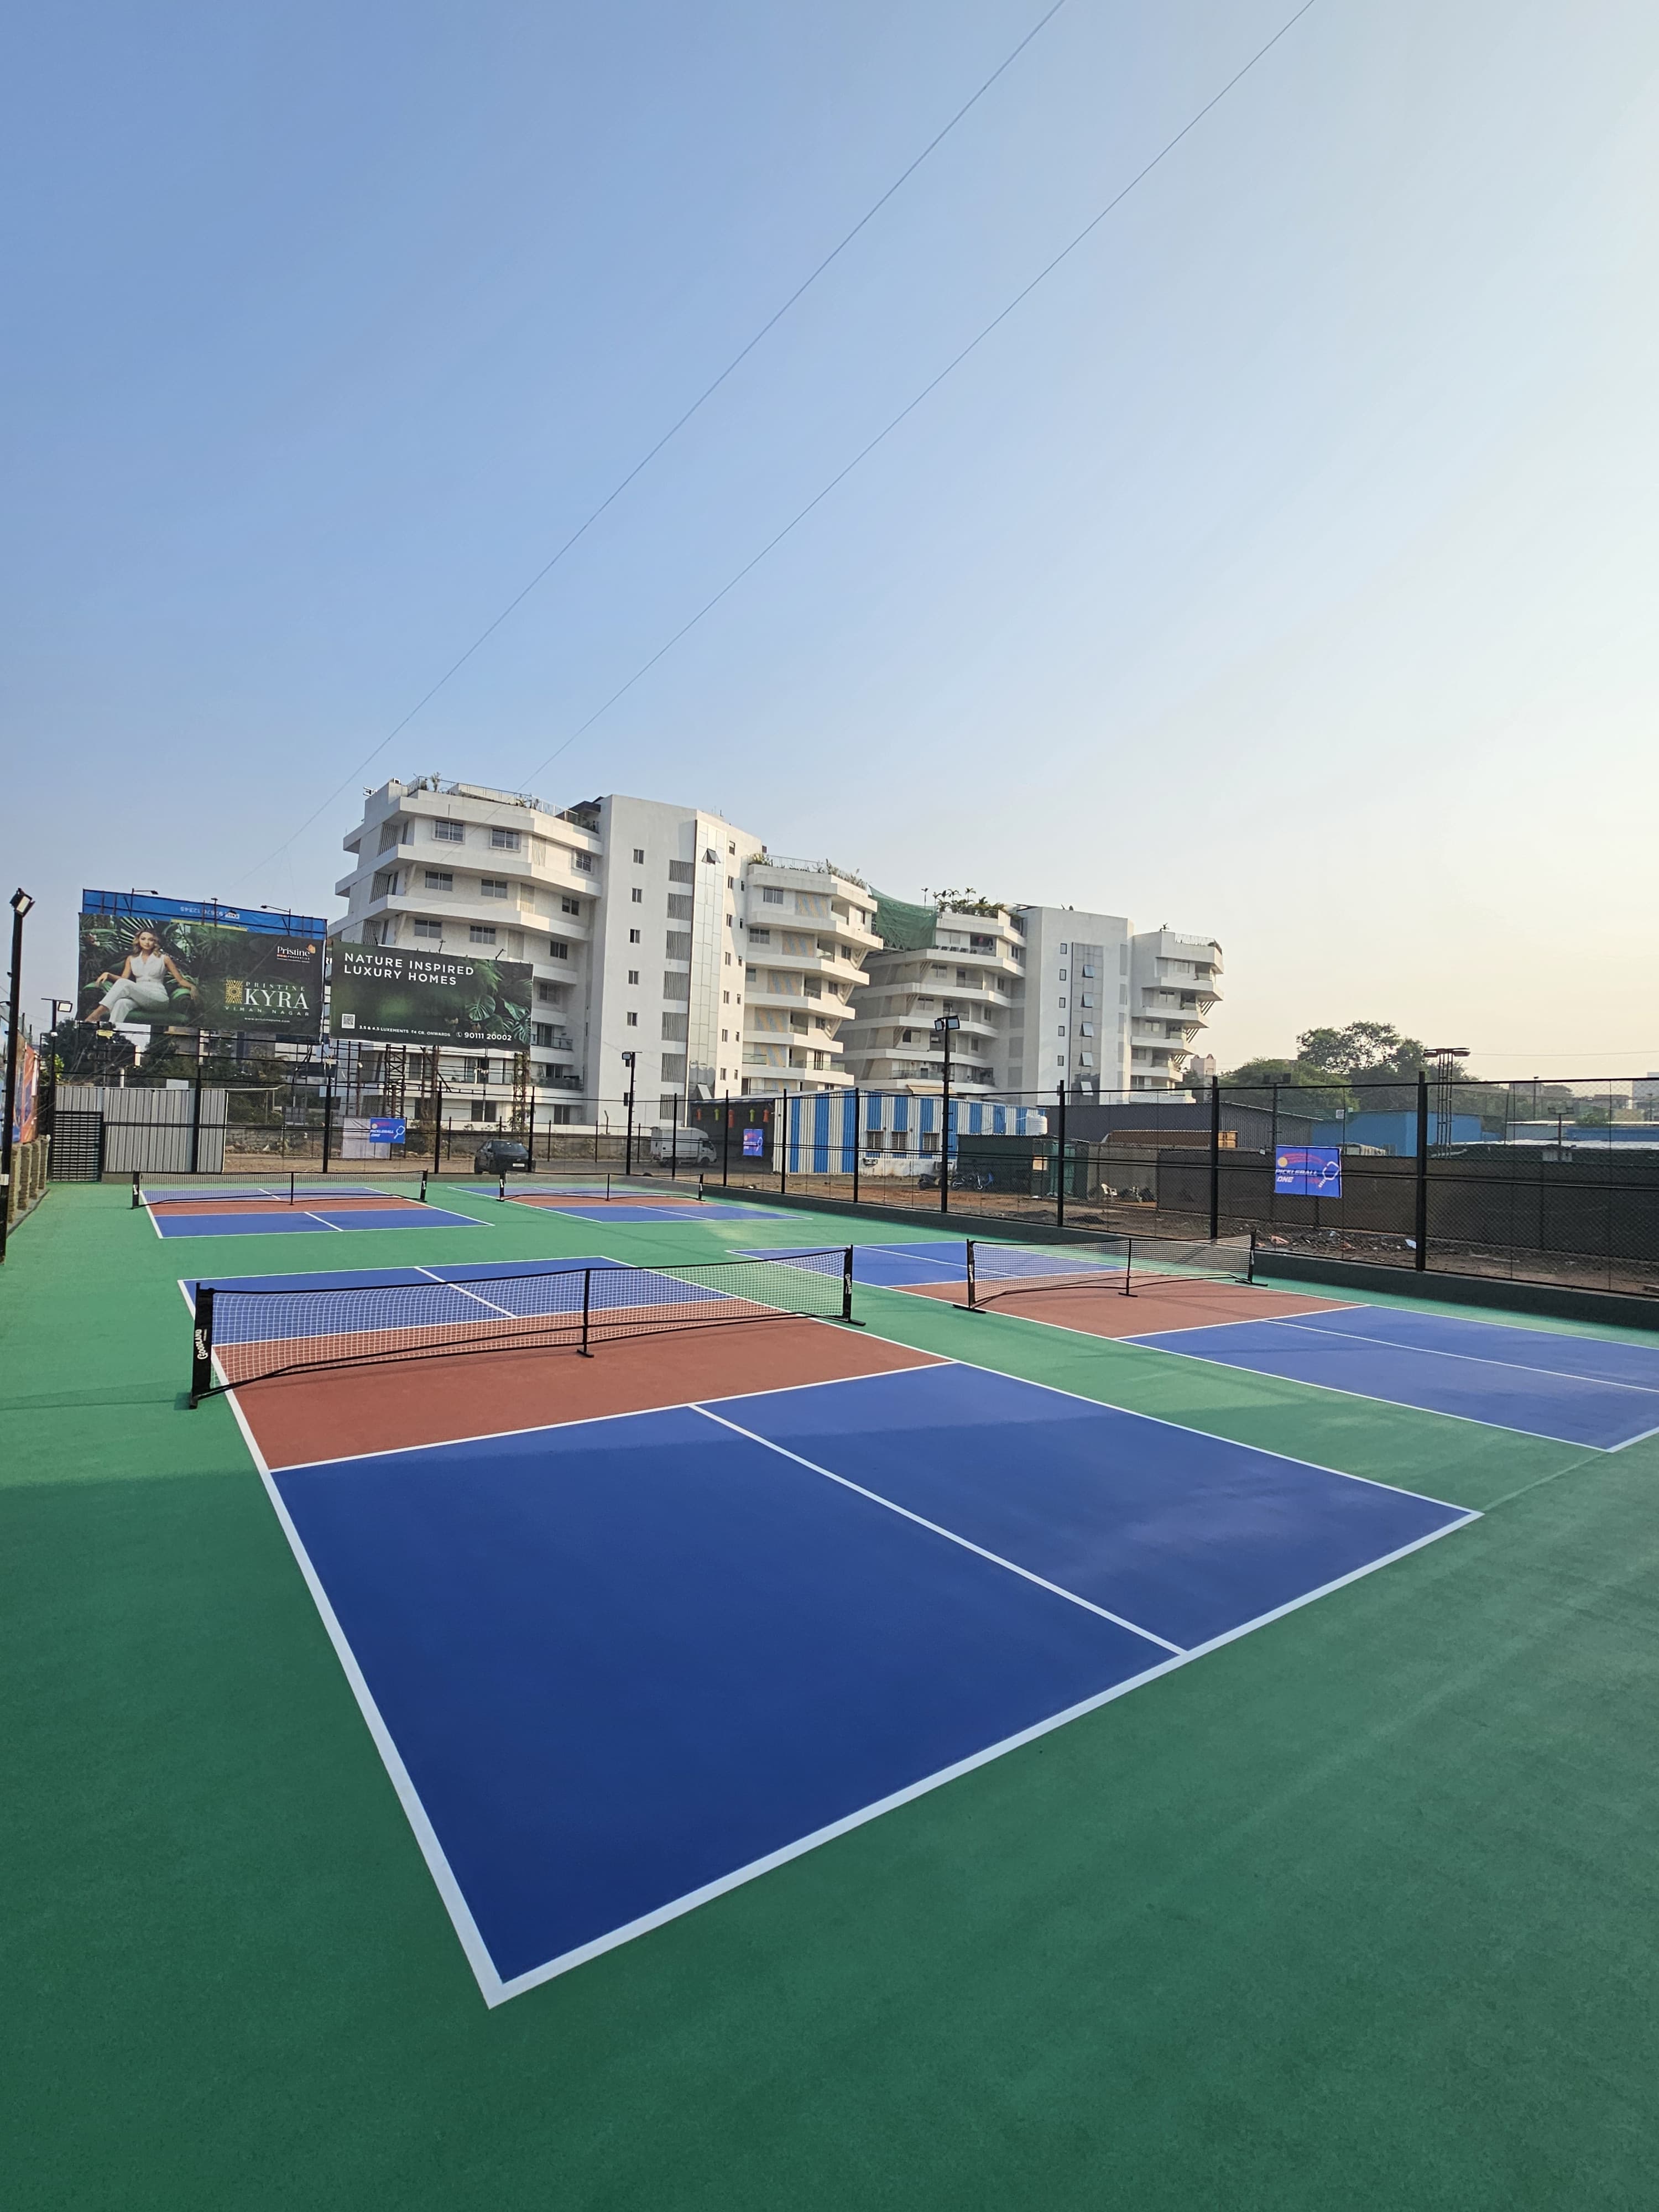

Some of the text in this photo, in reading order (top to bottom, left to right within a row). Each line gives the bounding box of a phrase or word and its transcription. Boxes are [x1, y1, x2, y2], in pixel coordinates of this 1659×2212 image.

[277, 946, 310, 957] Pristine
[345, 952, 403, 968] NATURE
[409, 960, 474, 975] INSPIRED
[344, 964, 456, 985] LUXURY HOMES
[246, 982, 305, 992] PRISTINE
[244, 988, 310, 1009] KYRA
